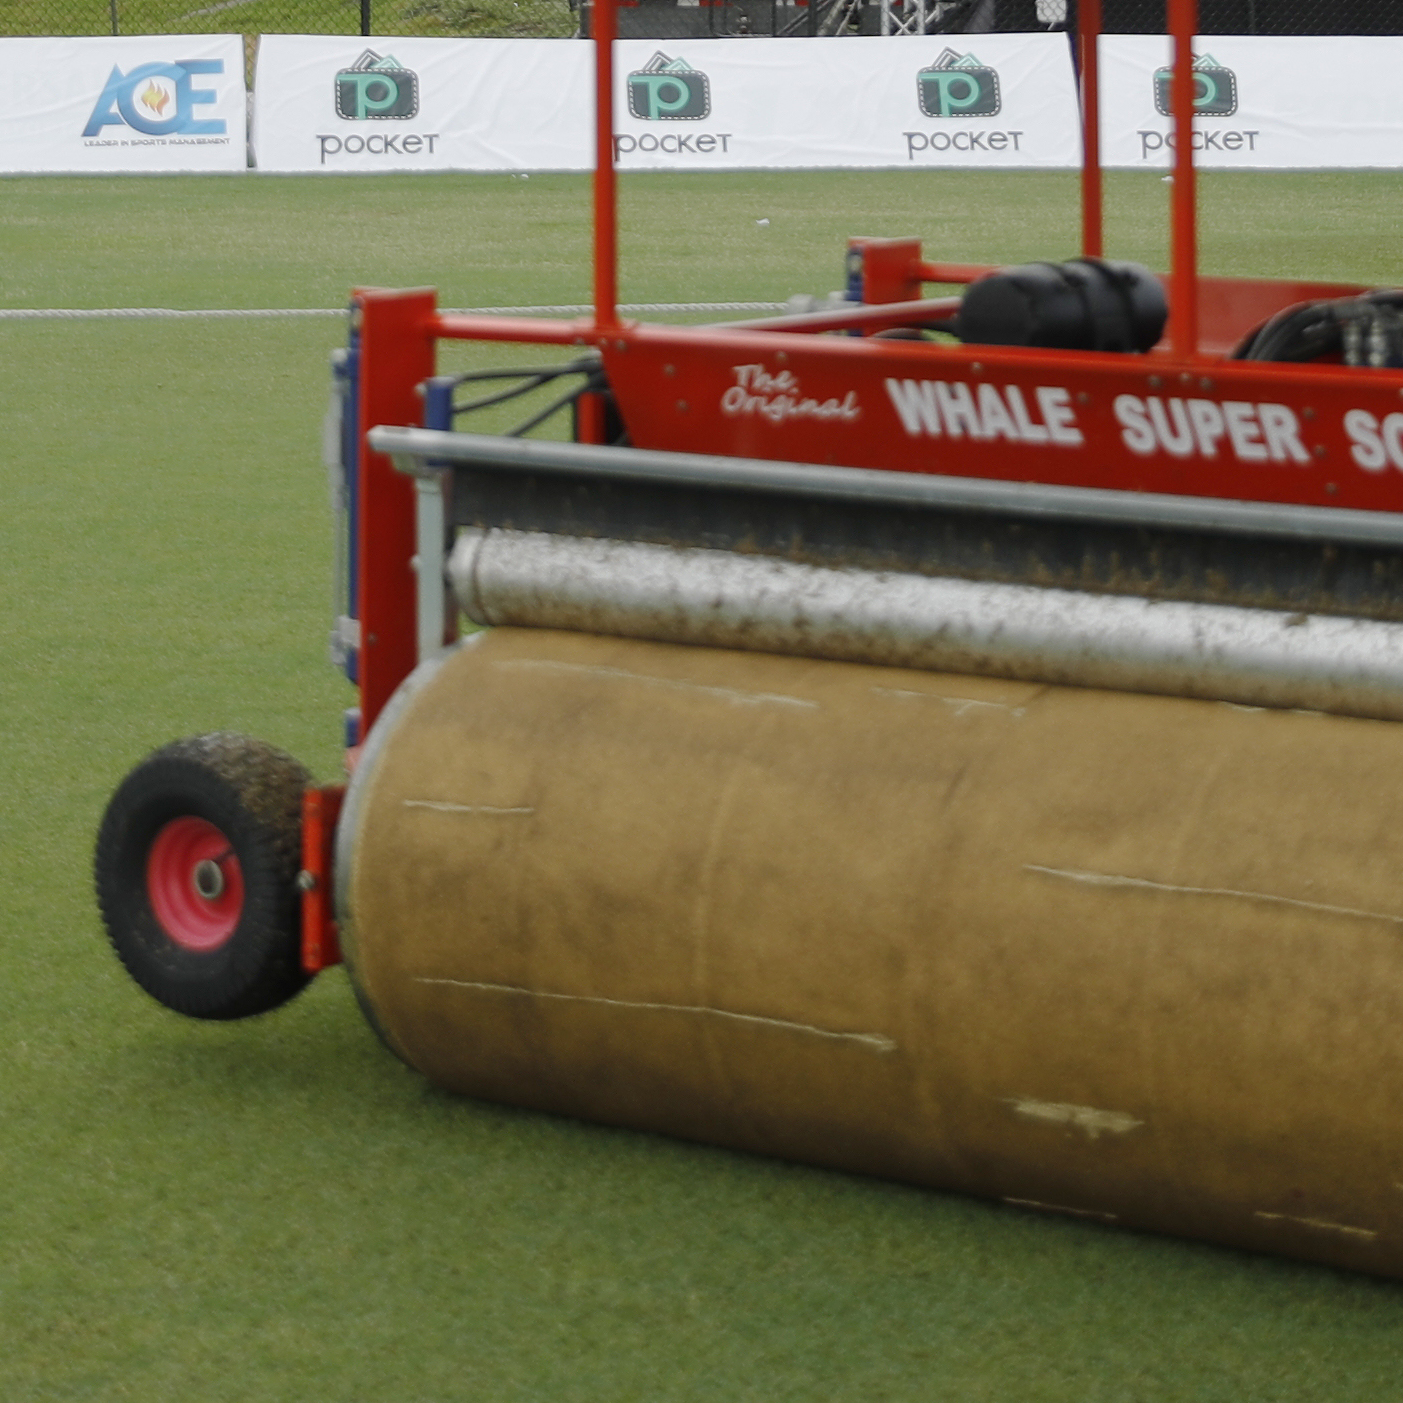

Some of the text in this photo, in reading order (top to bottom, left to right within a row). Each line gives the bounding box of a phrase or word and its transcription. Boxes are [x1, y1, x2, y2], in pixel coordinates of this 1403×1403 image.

[81, 59, 227, 137] ACE
[169, 138, 230, 146] MANAGEMENT
[721, 385, 863, 422] Original
[884, 376, 1086, 446] WHALE
[1112, 393, 1312, 466] SUPER
